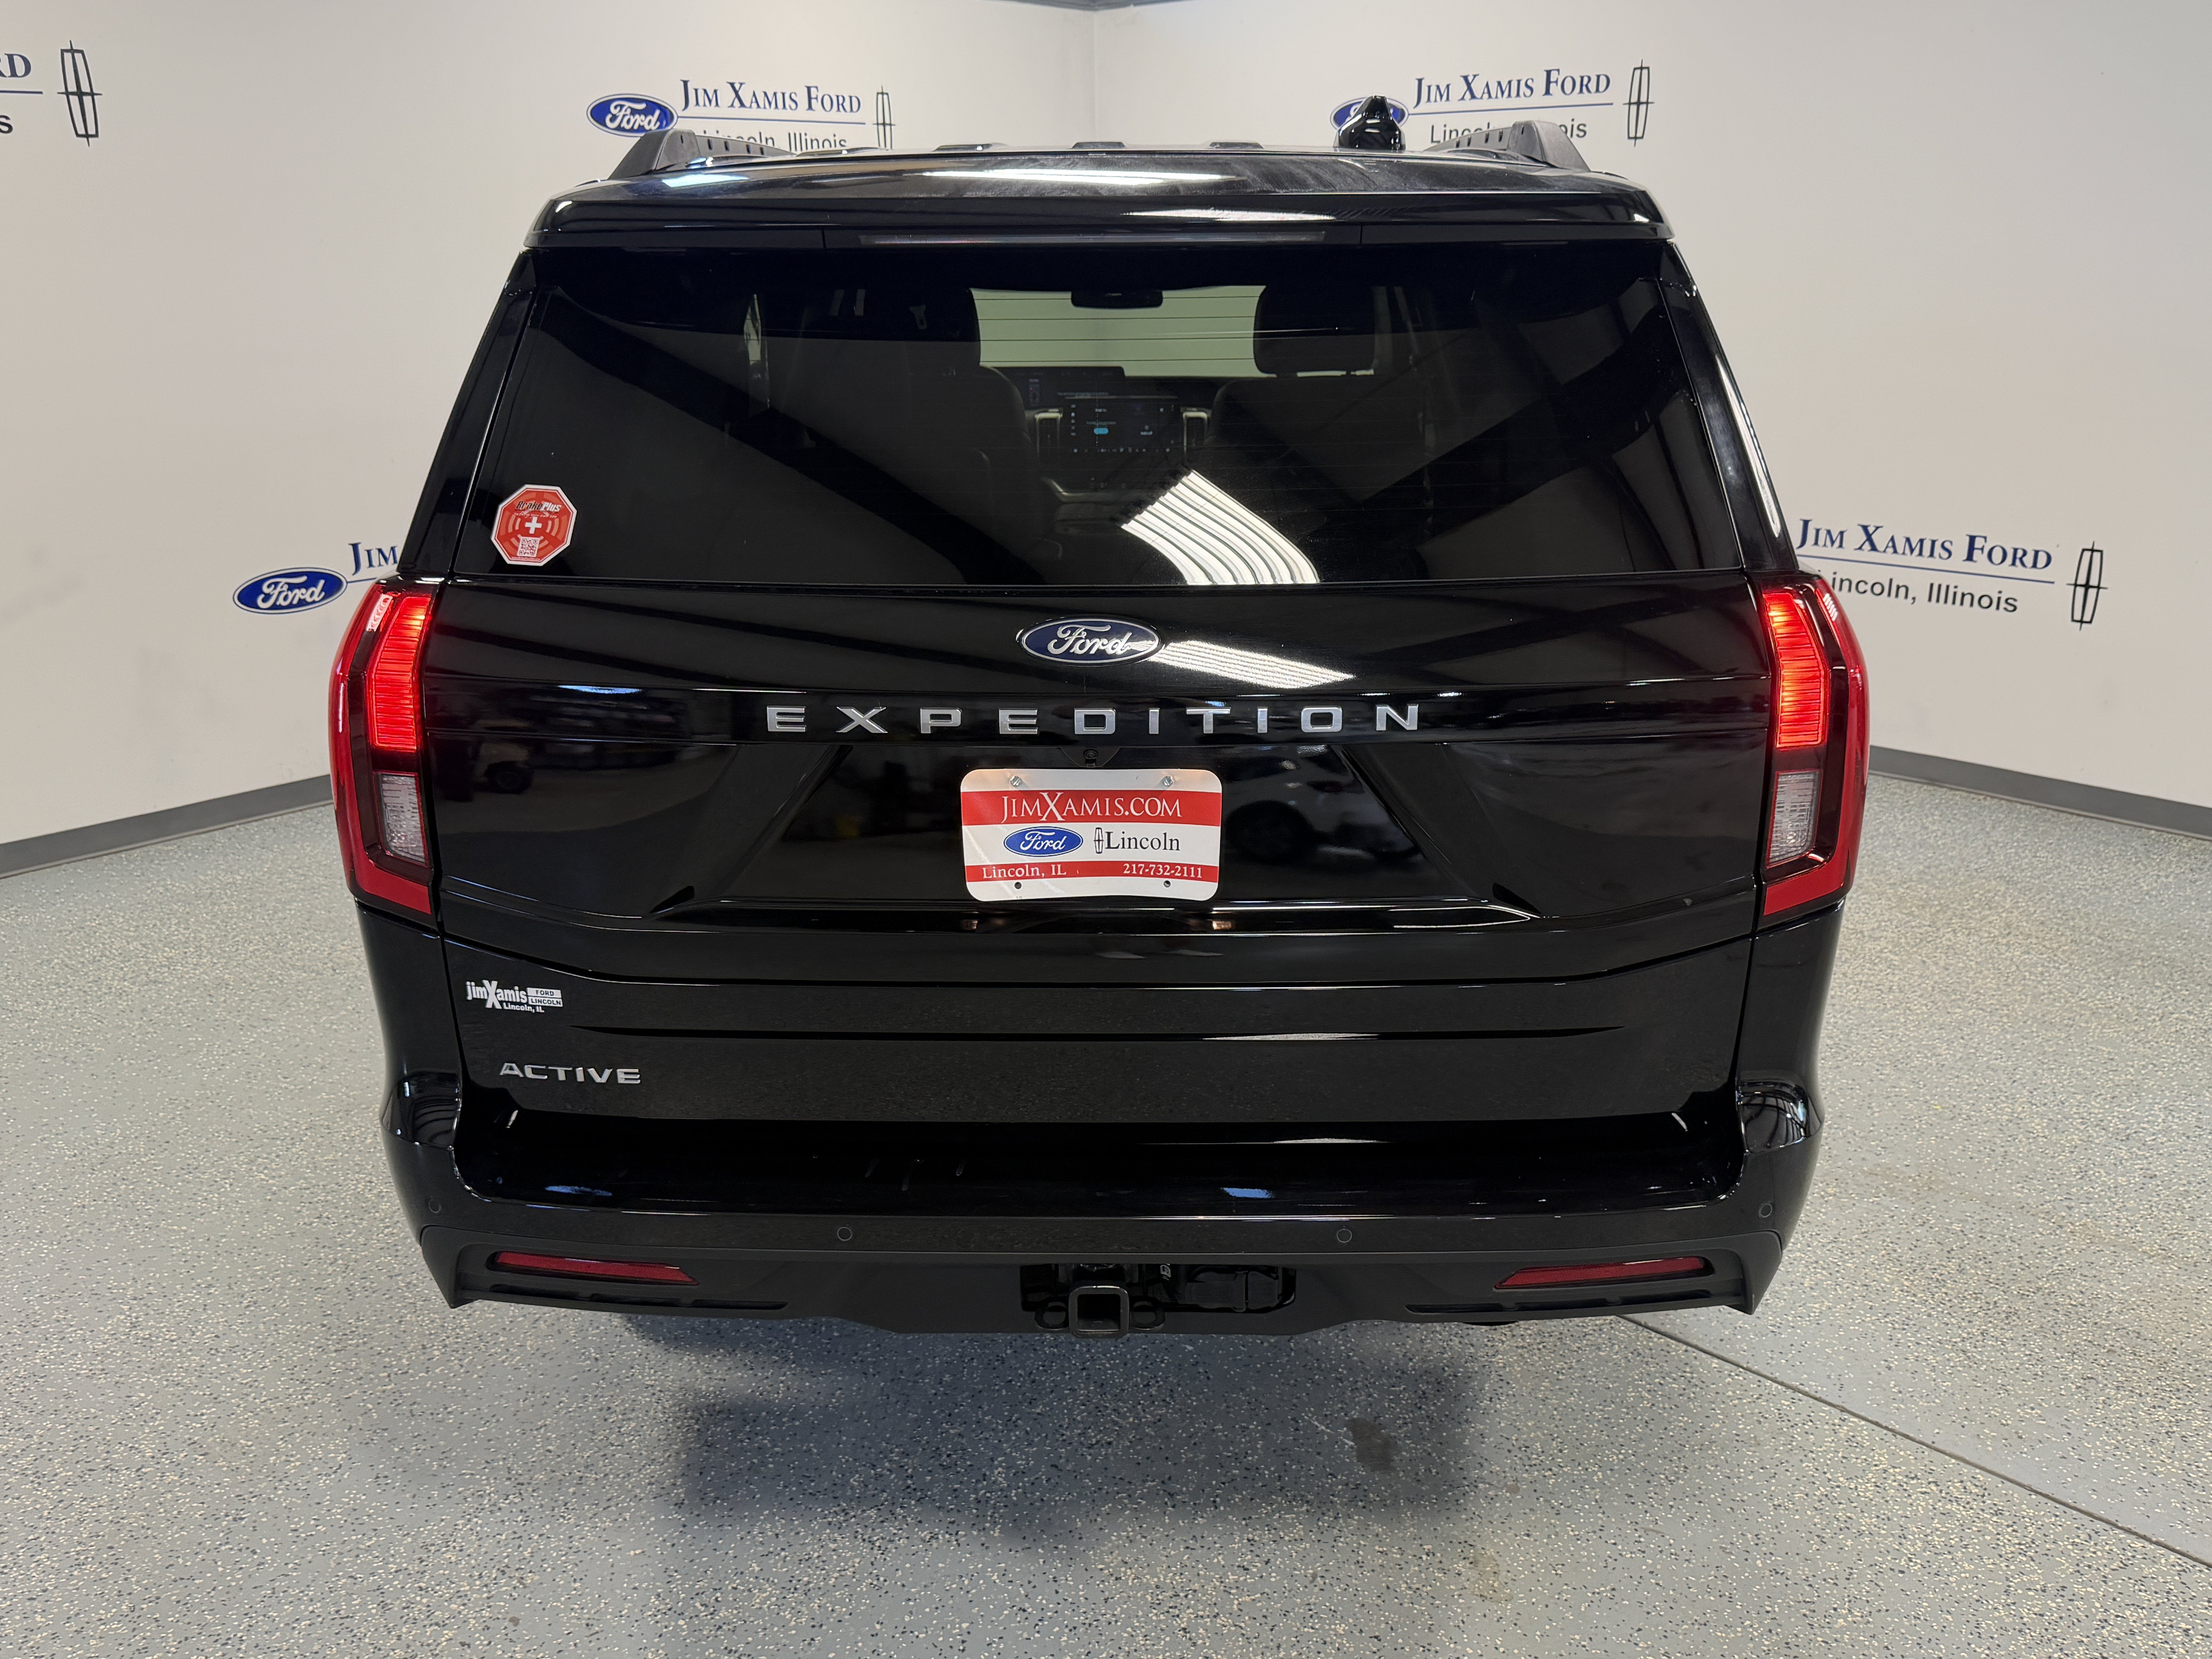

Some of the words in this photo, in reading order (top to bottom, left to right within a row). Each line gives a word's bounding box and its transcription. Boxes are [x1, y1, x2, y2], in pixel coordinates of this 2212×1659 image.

[681, 79, 721, 111] JIM
[726, 82, 798, 111] XAMIS
[805, 85, 861, 113] FORD
[1413, 77, 1451, 109] JIM
[1458, 74, 1534, 101] XAMIS
[1542, 68, 1611, 96] FORD
[605, 101, 661, 130] Ford
[349, 542, 398, 576] JIM
[1796, 519, 1847, 550] JIM
[1853, 524, 1954, 560] XAMIS
[1962, 534, 2052, 569] FORD
[257, 575, 325, 609] Ford
[1817, 570, 1916, 605] incoln,
[1927, 582, 2019, 612] Illinois
[1047, 625, 1132, 655] Ford
[766, 704, 1419, 735] EXPEDITION
[1001, 792, 1182, 824] JIMXAMIS.COM
[1020, 831, 1066, 851] Ford
[1105, 831, 1180, 851] Lincoln
[982, 864, 1045, 879] Lincoln,
[1051, 864, 1067, 876] IL
[1123, 863, 1202, 878] 217-732-2111
[503, 1002, 535, 1013] Lincoln,
[500, 1063, 641, 1084] ACTIVE
